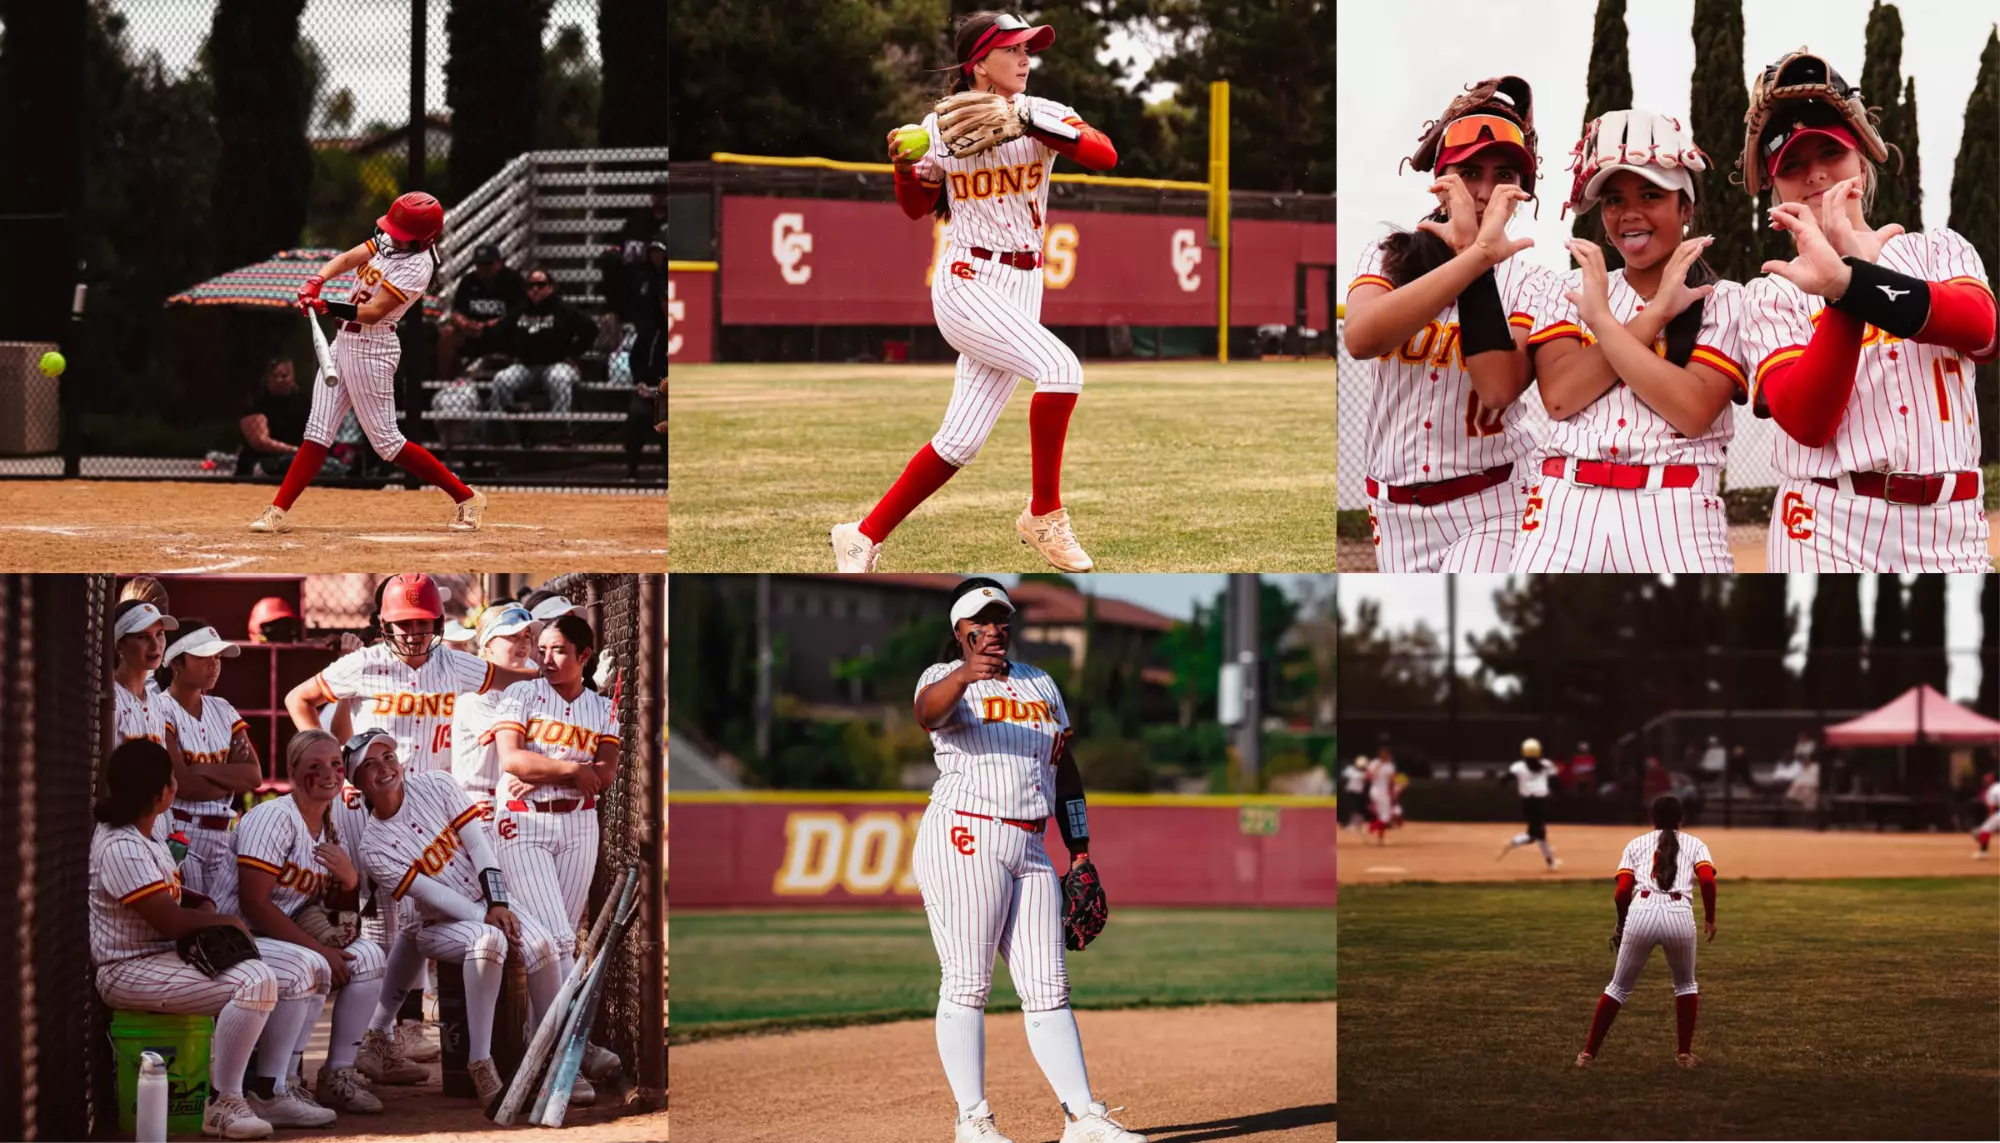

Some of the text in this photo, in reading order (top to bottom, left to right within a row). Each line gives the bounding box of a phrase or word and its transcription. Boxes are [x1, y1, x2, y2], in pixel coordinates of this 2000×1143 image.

[950, 160, 1044, 201] DONS
[772, 212, 813, 285] CC
[1171, 228, 1202, 292] CC
[1782, 490, 1815, 541] CC
[371, 691, 457, 719] DONS
[525, 718, 602, 757] DONS
[772, 811, 926, 896] DO
[950, 826, 976, 856] CC
